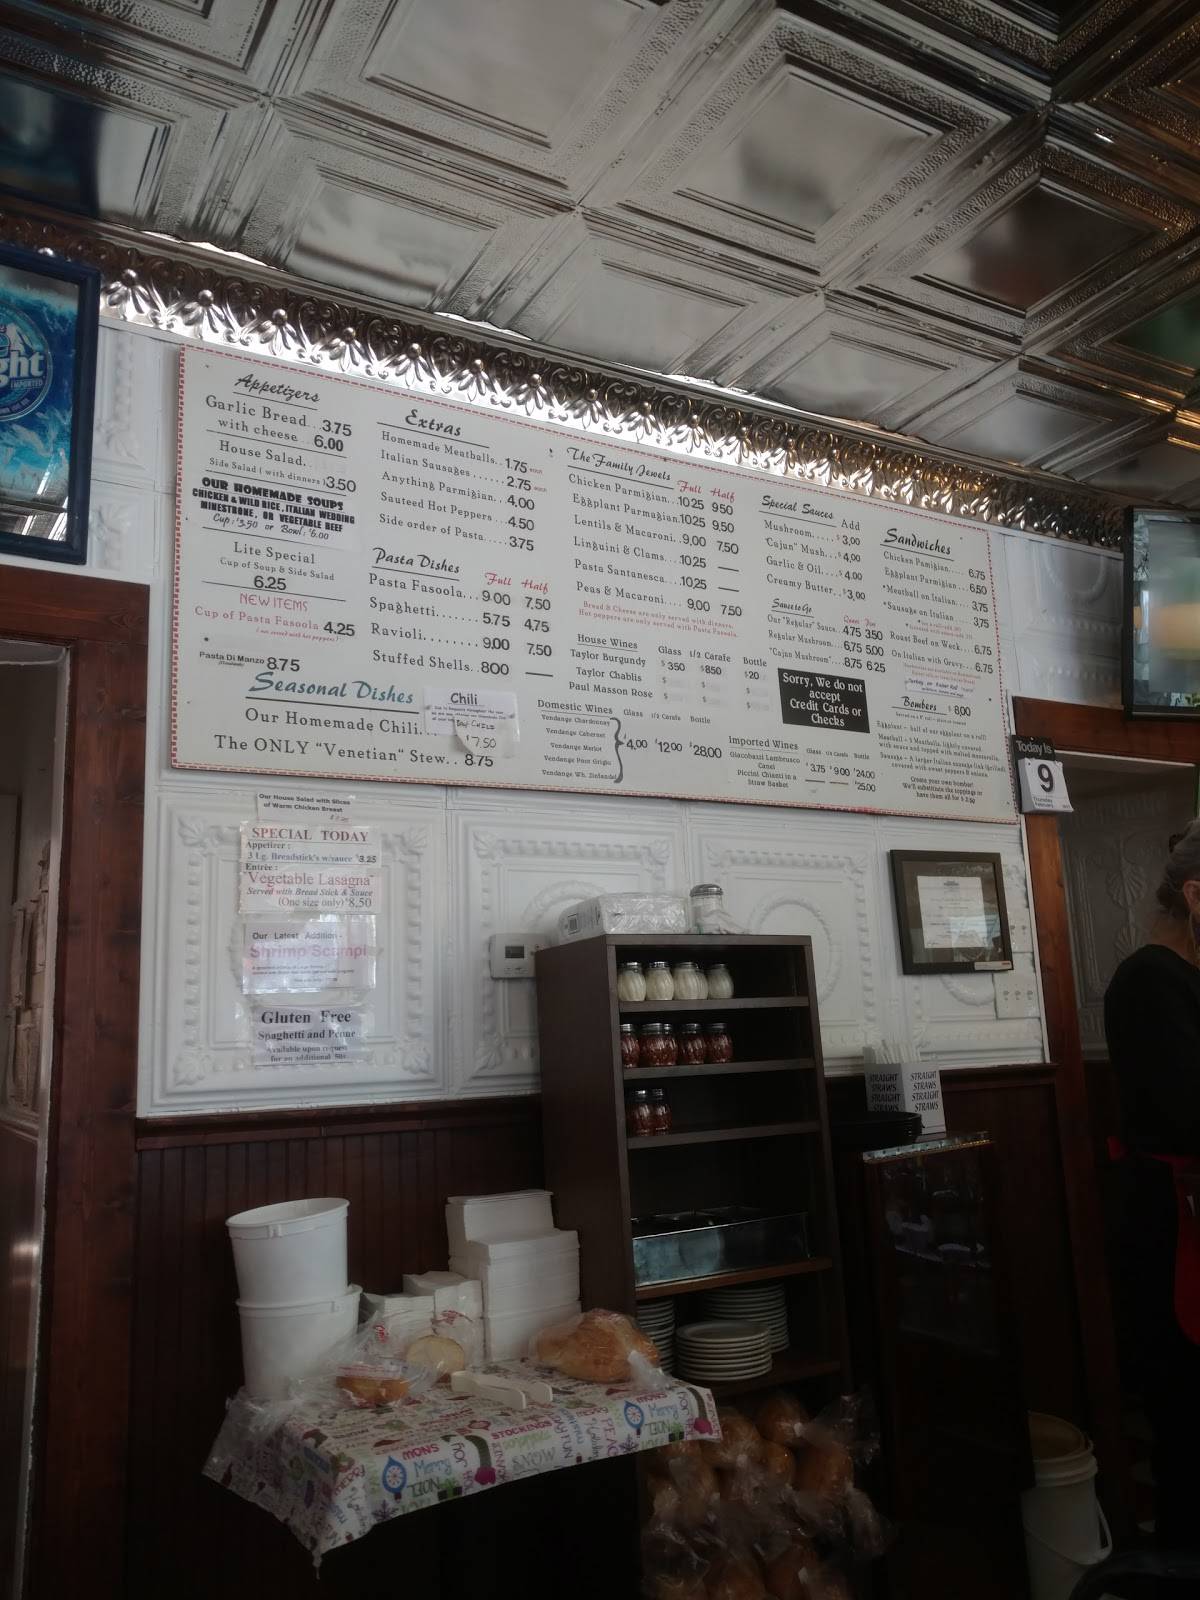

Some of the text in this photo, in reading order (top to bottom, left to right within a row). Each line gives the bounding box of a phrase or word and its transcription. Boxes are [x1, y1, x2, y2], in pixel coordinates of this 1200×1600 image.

[235, 373, 320, 402] Appetizers
[206, 395, 352, 436] Garlic Bread 3.75
[405, 409, 461, 436] Extras
[218, 419, 344, 451] with cheese 6.00
[382, 431, 439, 452] Homemade
[444, 444, 495, 464] Meatballs
[505, 458, 527, 473] 1.75
[567, 447, 671, 480] The Family Jewels
[210, 457, 356, 492] Side Salad 3.50
[381, 450, 418, 466] Italian
[422, 459, 470, 477] Sausages
[507, 476, 531, 491] 2.75
[202, 477, 343, 510] OUR HOMEMADE SOUPS
[382, 472, 534, 510] Anything Parmigian 4.00
[381, 492, 534, 531] Sauteed Hot Peppers 4.50
[762, 495, 860, 531] Special Sauces Add
[380, 514, 403, 526] Side
[407, 520, 436, 532] order
[455, 527, 484, 541] Pasta
[575, 515, 739, 554] Lentils & Macaroni 9.00 7.50
[234, 542, 315, 564] Lite Special
[573, 536, 664, 561] Linguini & Clams
[884, 528, 951, 555] Sandwiches
[220, 558, 238, 567] Cup
[254, 562, 276, 573] Soup
[288, 567, 307, 577] Side
[310, 570, 335, 580] Salad
[372, 547, 460, 574] Pasta Dishes
[254, 575, 287, 590] 6.25
[485, 572, 548, 594] Full Half
[240, 593, 308, 611] NEW ITEMS
[576, 582, 742, 617] Peas & Macaroni 9.00 7.50
[195, 607, 355, 636] Cup of Pasta Fasoola 4.25
[370, 597, 549, 632] Spaghetti 5.75 4.75
[371, 623, 552, 656] Ravioli 9.00 7.50
[577, 634, 638, 649] House Wines
[890, 632, 910, 641] Roast
[912, 634, 928, 645] Beef
[974, 645, 992, 656] 6.75
[658, 646, 767, 667] Glass 1/2 Carafe Bottle
[576, 667, 642, 681] Taylor Chablis
[783, 673, 863, 693] Sorry, We do not
[248, 672, 413, 704] Seasonal Dishes
[451, 693, 478, 704] Chili
[569, 682, 590, 692] Paul
[594, 685, 627, 696] Masson
[809, 690, 841, 702] accept
[538, 700, 612, 714] Domestic Wines
[790, 698, 861, 716] Credit Cards or
[246, 707, 278, 722] Our
[286, 712, 373, 732] Homemade
[811, 713, 845, 727] Checks
[214, 735, 248, 751] The
[254, 739, 309, 755] ONLY
[410, 750, 446, 764] Stew
[729, 736, 798, 750] Imported Wines
[1016, 740, 1051, 755] Today Is
[1038, 764, 1053, 792] 9
[252, 828, 368, 842] SPECIAL TODAY
[295, 888, 318, 896] Bread
[261, 1011, 351, 1024] Gluten Free
[258, 1031, 304, 1041] Spaghetti
[911, 1071, 936, 1081] STRAIGHT
[913, 1081, 936, 1091] STRAWS
[912, 1091, 939, 1101] STRAIGHT
[915, 1102, 938, 1112] STRAWS
[492, 1420, 552, 1440] STOCKINGS
